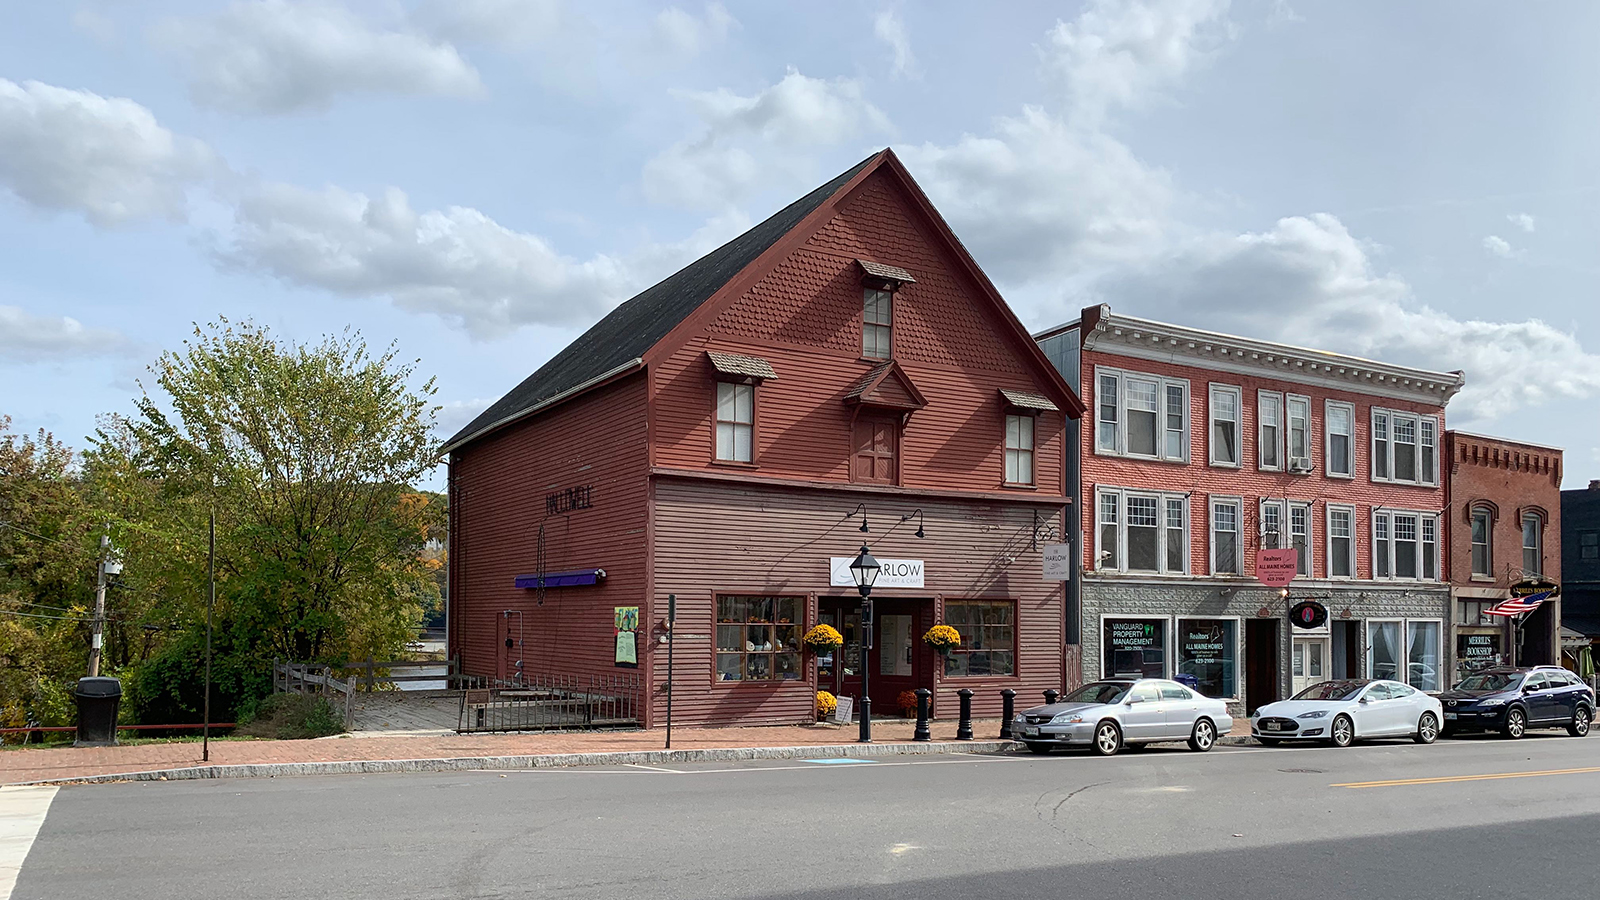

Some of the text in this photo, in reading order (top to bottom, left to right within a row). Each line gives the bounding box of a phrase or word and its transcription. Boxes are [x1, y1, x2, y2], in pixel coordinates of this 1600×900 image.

[1045, 554, 1067, 562] HARLOW
[879, 563, 921, 577] RLOW
[1113, 630, 1143, 638] PROPERTY
[1467, 646, 1492, 655] BOOKSHOP
